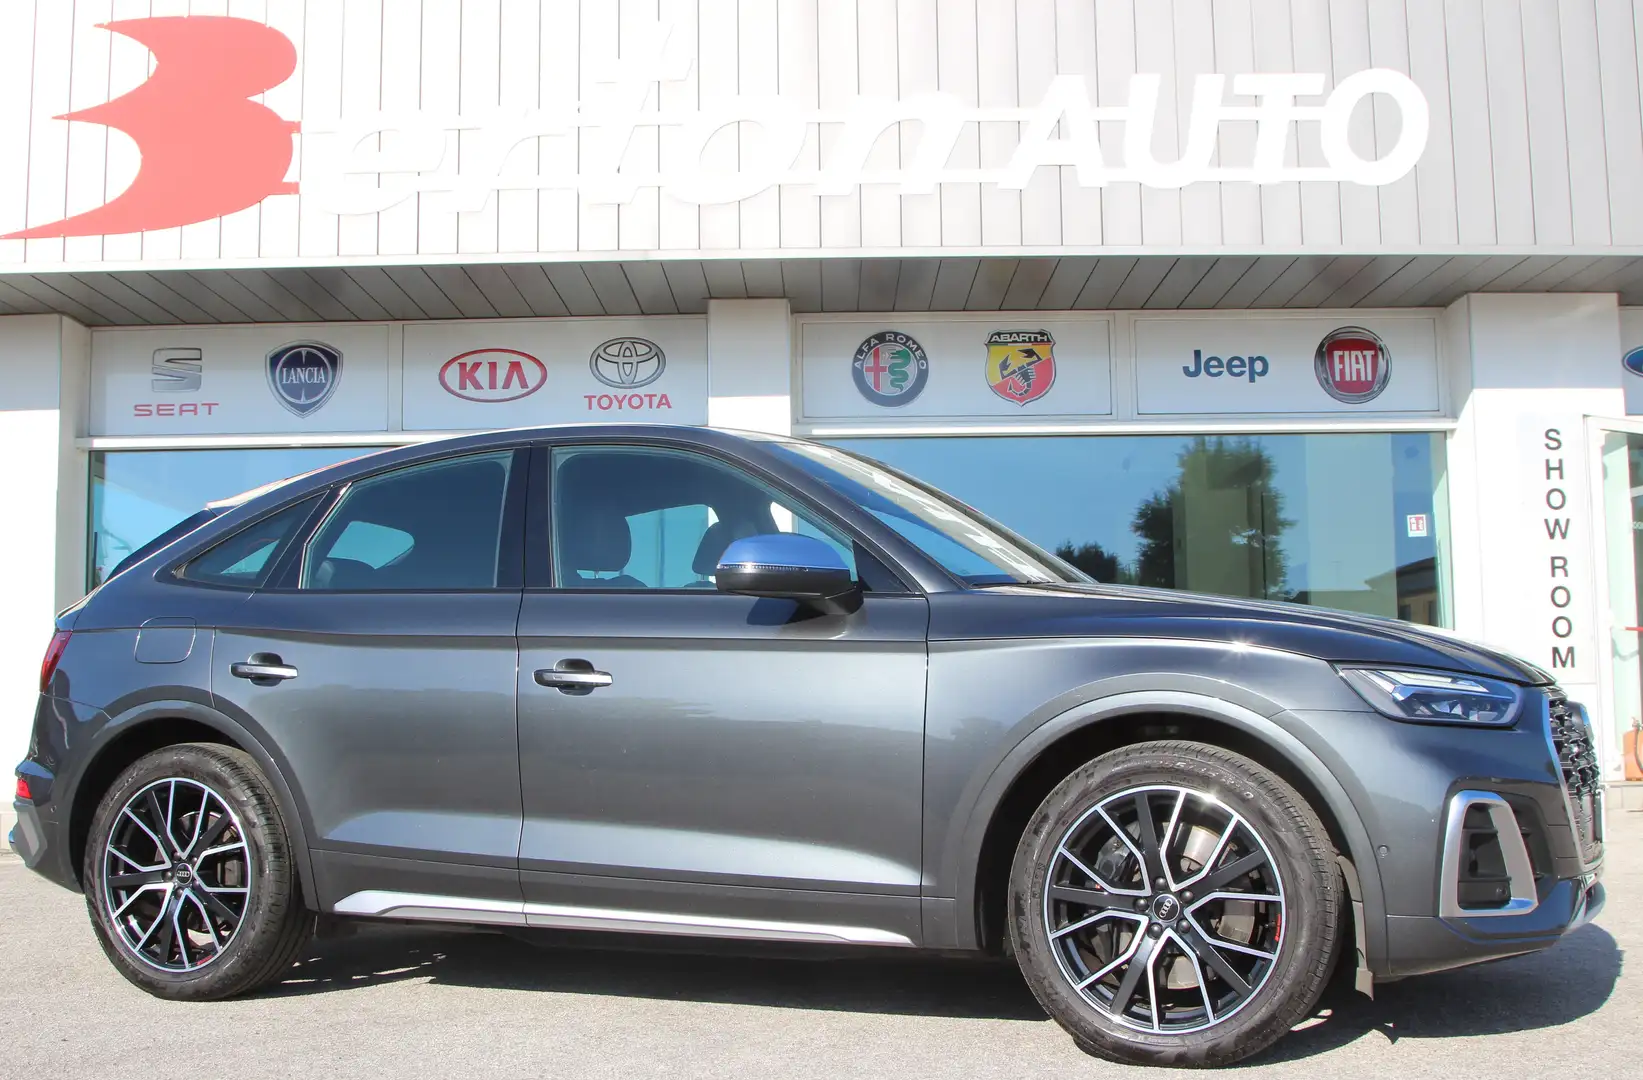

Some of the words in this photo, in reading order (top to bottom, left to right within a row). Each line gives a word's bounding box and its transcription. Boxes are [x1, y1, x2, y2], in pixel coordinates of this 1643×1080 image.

[998, 67, 1430, 189] AUTO
[854, 337, 879, 370] ALFA
[885, 333, 927, 370] ROMEO
[990, 333, 1048, 343] ABARTH
[281, 367, 326, 384] LANCIA
[457, 361, 530, 390] KIA
[1182, 349, 1269, 383] Jeep
[1333, 350, 1375, 382] FIAT
[133, 402, 219, 417] SEAT
[583, 393, 672, 411] TOYOTA
